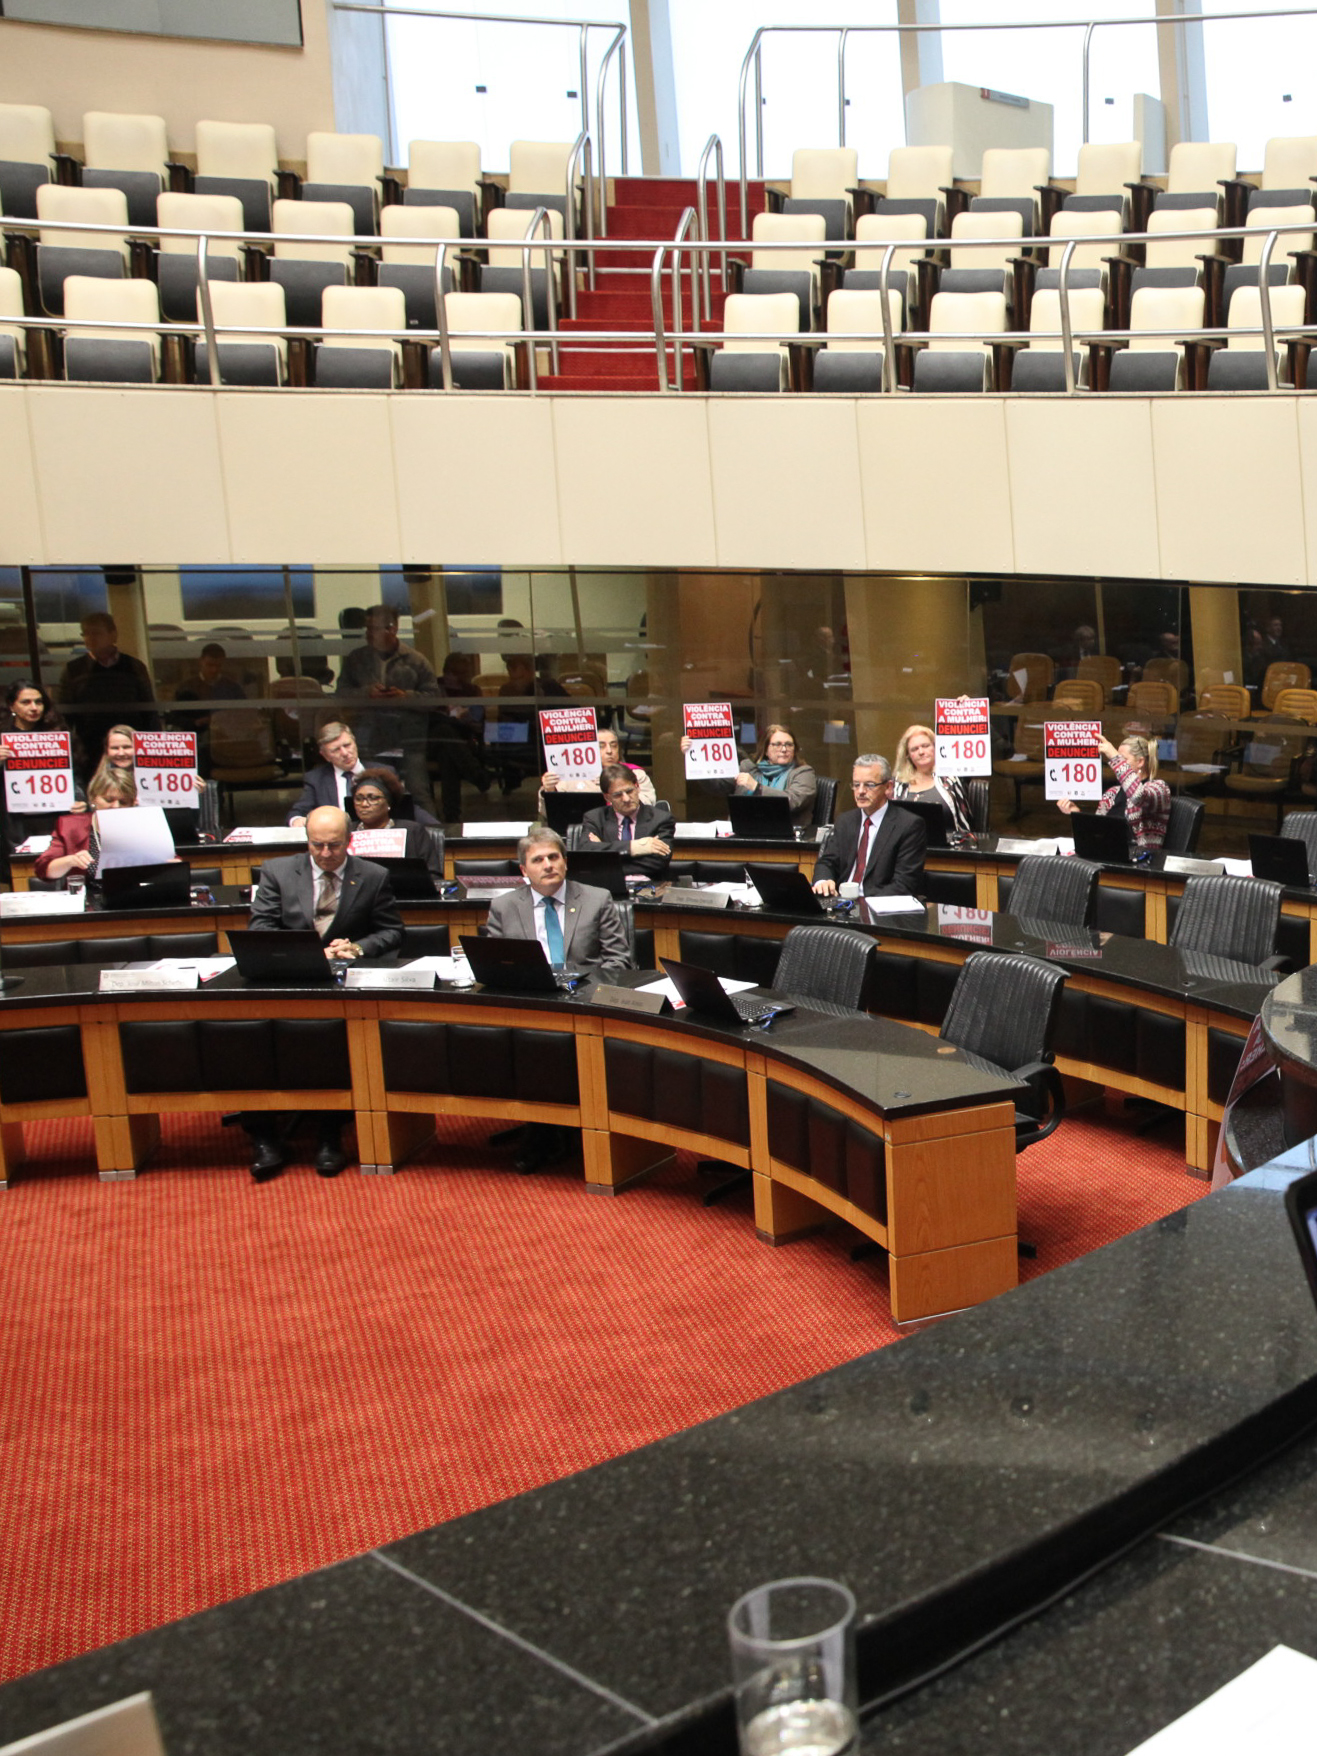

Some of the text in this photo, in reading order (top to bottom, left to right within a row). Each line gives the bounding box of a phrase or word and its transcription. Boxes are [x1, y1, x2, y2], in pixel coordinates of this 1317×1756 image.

[939, 700, 986, 708] VIOLÊNCIA
[543, 709, 592, 719] VIOLÊNCIA
[947, 715, 987, 723] MULHER:
[550, 717, 587, 726] CONTRA
[694, 719, 731, 727] MULHER:
[553, 724, 595, 732] MULHER:
[938, 724, 987, 734] DENUNCIE!
[1048, 723, 1098, 731] VIOLÊNCIA
[6, 733, 66, 742] VIOLÊNCIA
[136, 733, 193, 741] VIOLÊNCIA
[546, 732, 595, 744] DENUNCIE!
[687, 728, 732, 738] DENUNCIE!
[14, 742, 60, 750] CONTRA
[952, 740, 986, 759] 180
[18, 749, 68, 757] MULHER:
[146, 748, 194, 756] MULHER:
[562, 747, 596, 766] 180
[701, 743, 733, 761] 180
[1048, 747, 1099, 757] DENUNCIE!
[8, 758, 68, 769] DENUNCIE!
[137, 757, 194, 767] DENUNCIE!
[1062, 763, 1097, 782] 180
[26, 774, 67, 794] 180
[154, 773, 193, 792] 180
